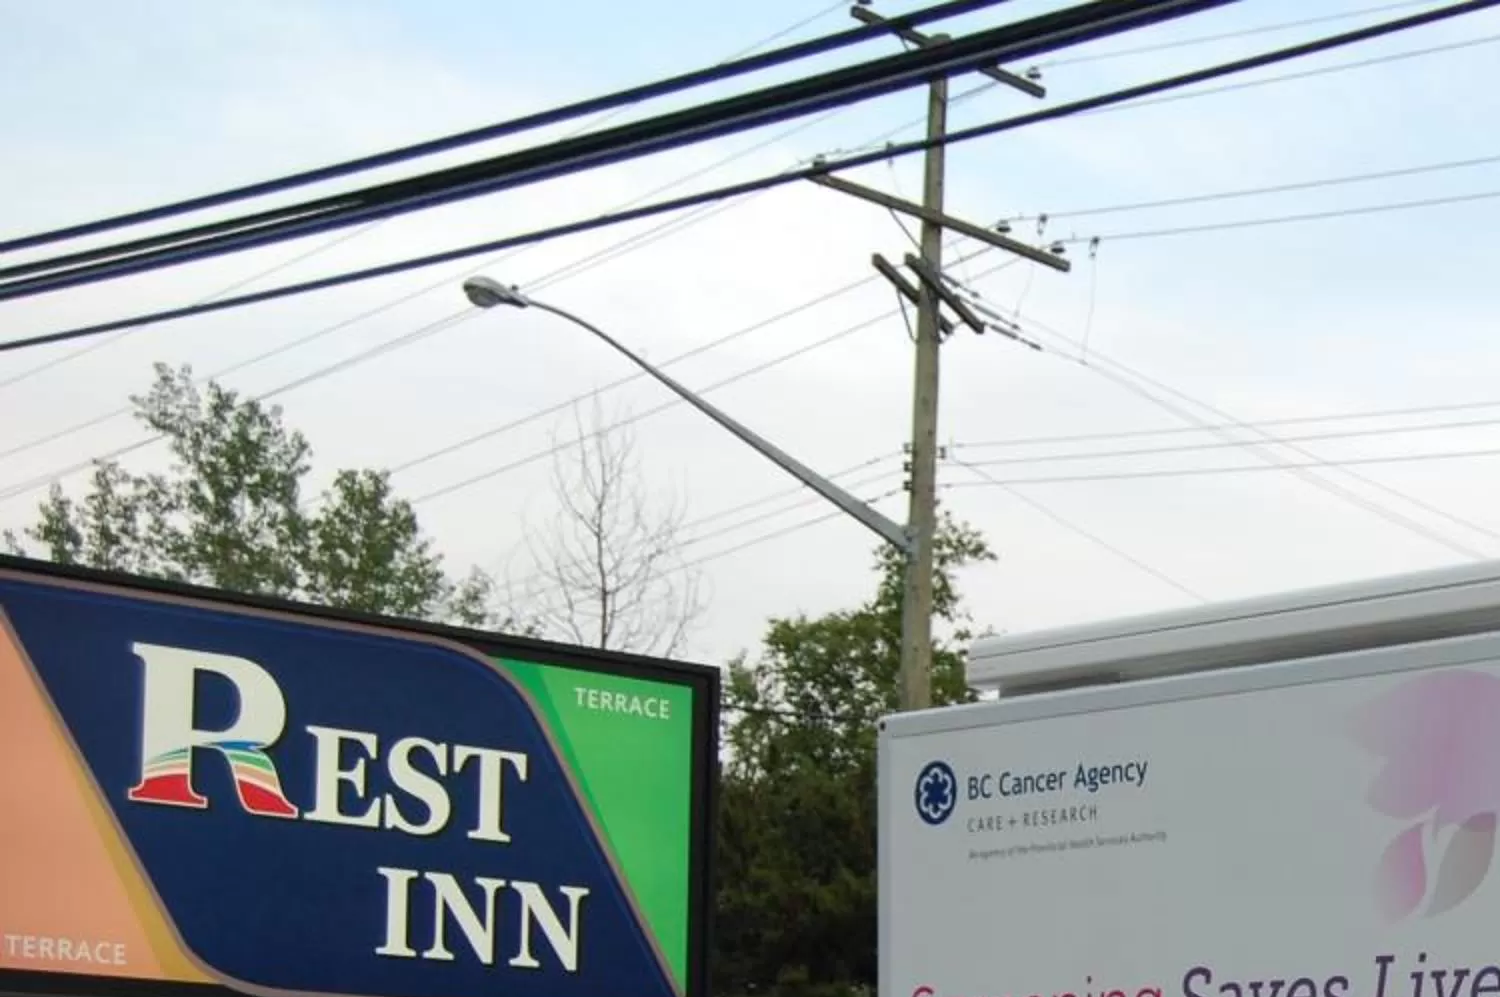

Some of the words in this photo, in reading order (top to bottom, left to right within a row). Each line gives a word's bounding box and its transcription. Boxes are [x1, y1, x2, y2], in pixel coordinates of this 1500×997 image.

[574, 686, 671, 721] TERRACE
[128, 642, 528, 843] REST
[967, 775, 993, 801] BC
[998, 770, 1067, 797] Cancer
[1073, 760, 1149, 793] Agency
[966, 814, 1003, 834] CARE
[1023, 804, 1098, 828] RESEARCH
[375, 866, 590, 972] INN
[4, 933, 128, 967] TERRACE
